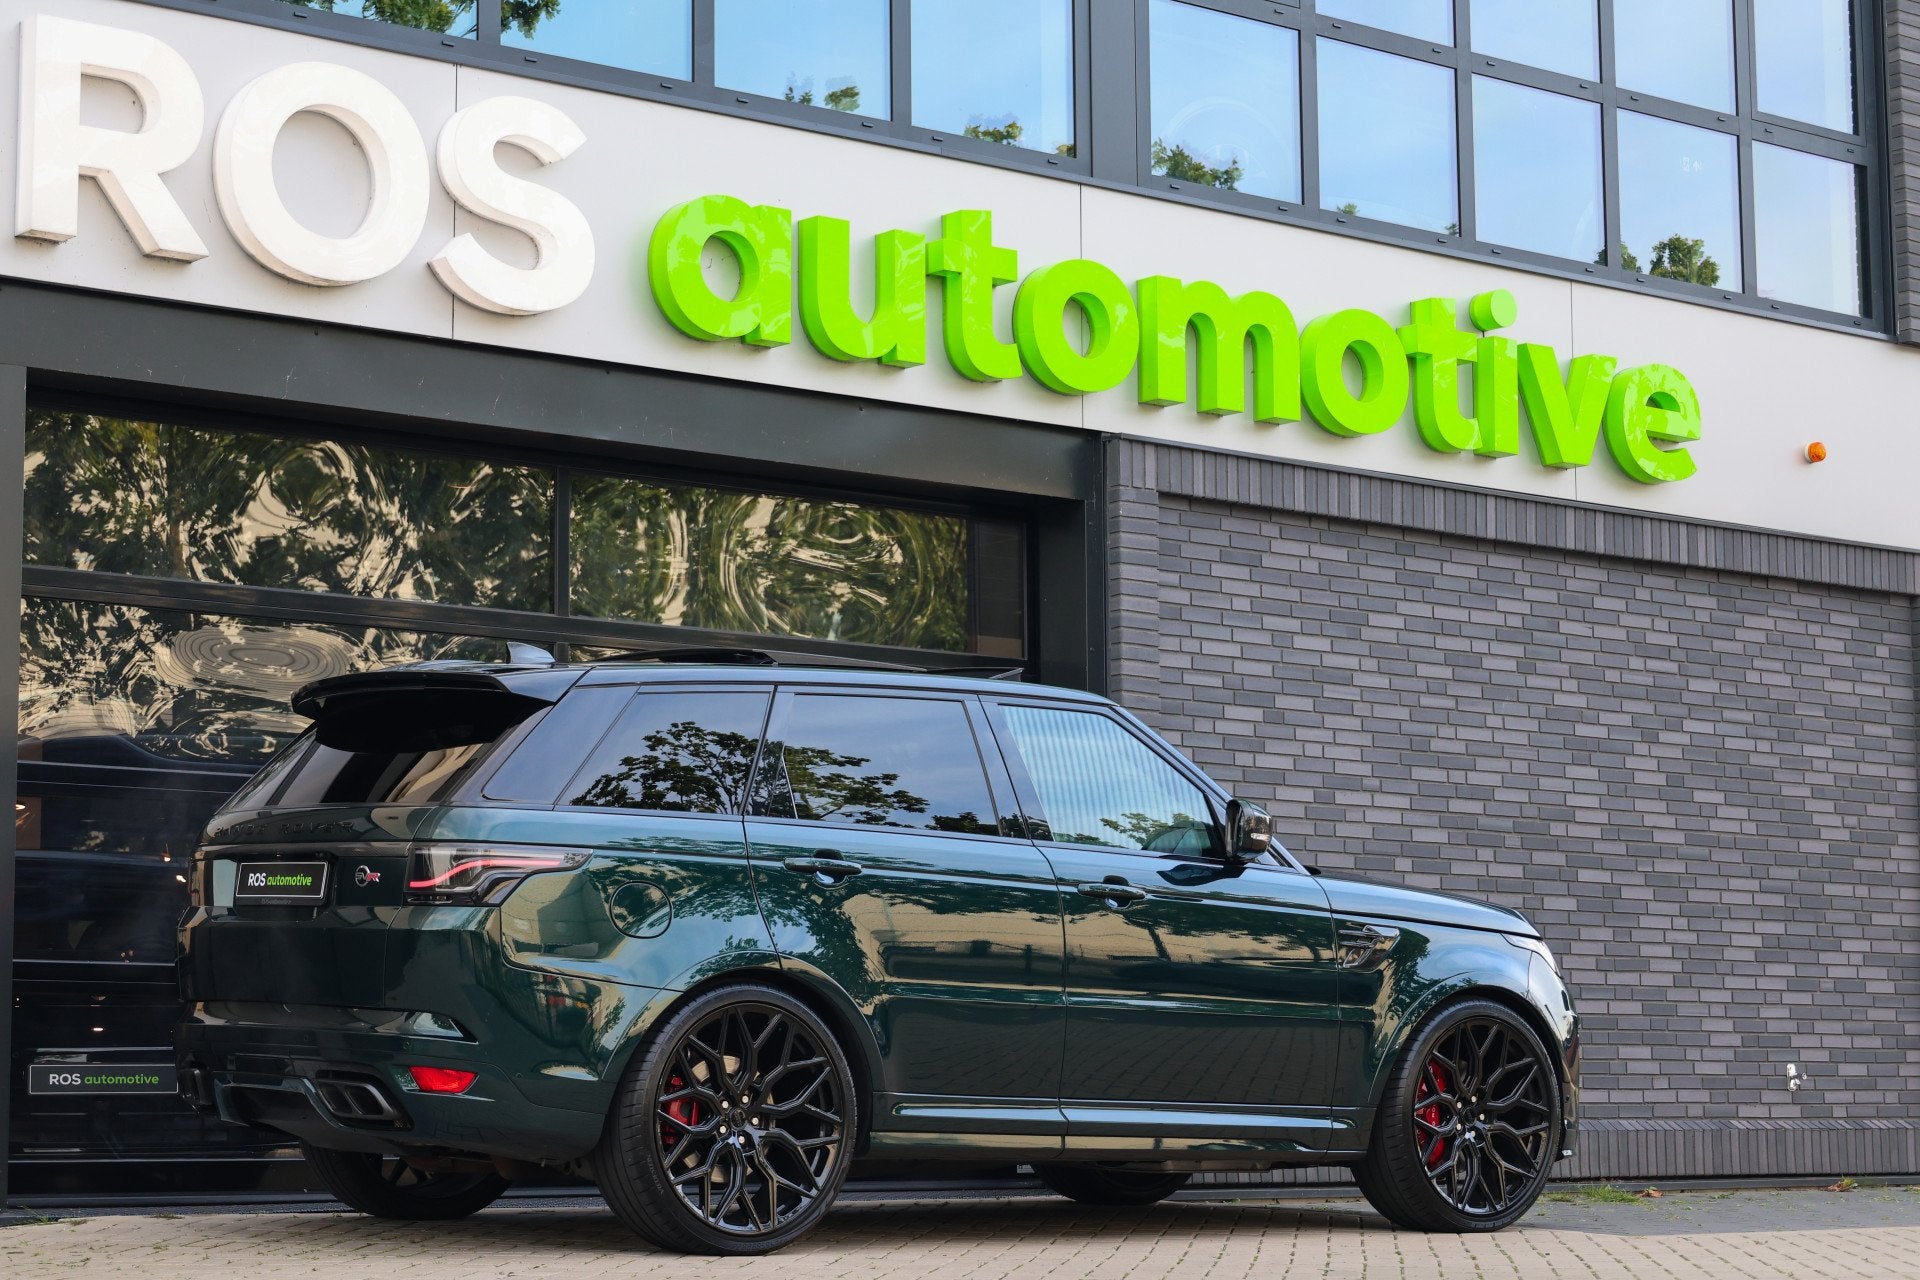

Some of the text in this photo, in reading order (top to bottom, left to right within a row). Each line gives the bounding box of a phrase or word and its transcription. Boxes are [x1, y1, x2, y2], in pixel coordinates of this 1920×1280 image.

[14, 13, 1702, 484] ROS automotive
[247, 873, 312, 887] ROS automotive
[49, 1073, 159, 1085] ROS automotive
